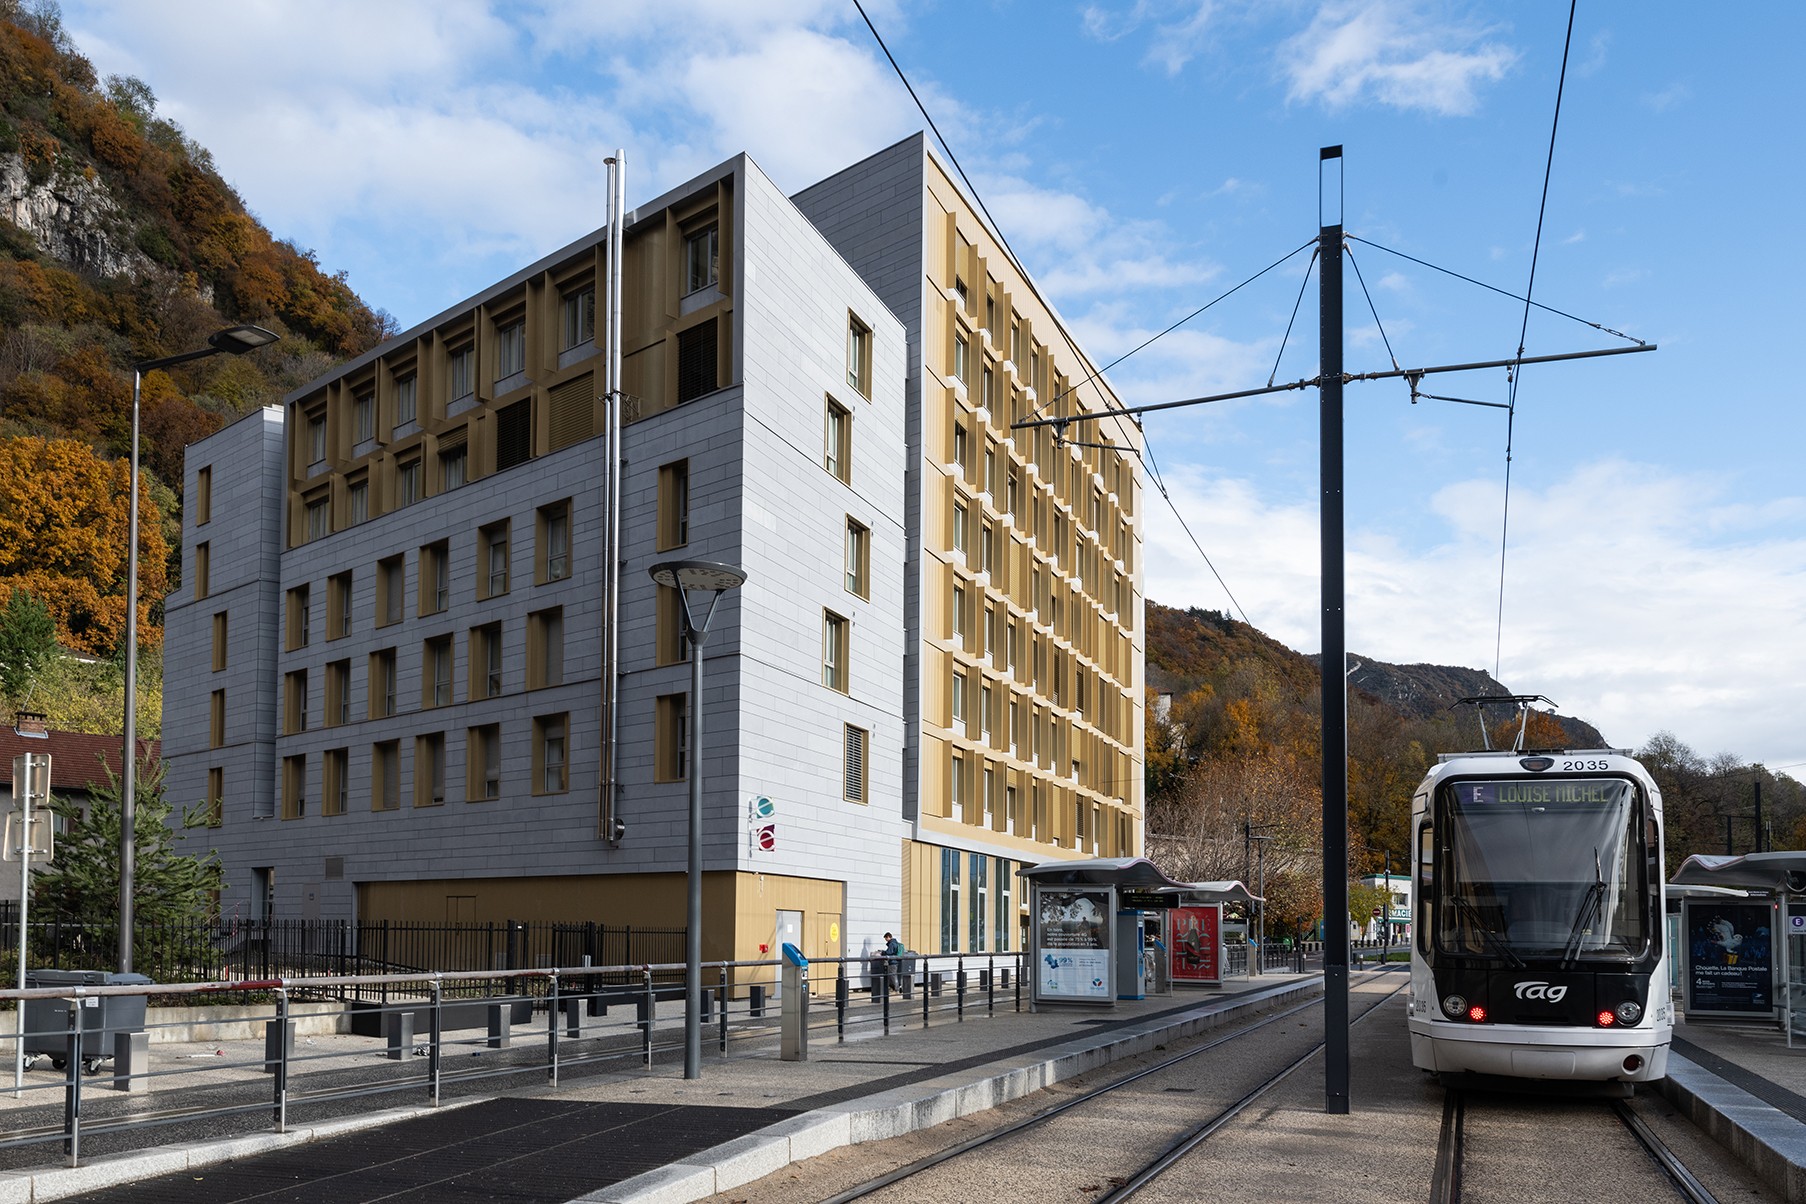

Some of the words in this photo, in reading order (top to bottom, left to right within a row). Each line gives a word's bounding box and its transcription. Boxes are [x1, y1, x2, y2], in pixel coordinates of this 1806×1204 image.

[1563, 760, 1609, 771] 2035
[1473, 786, 1484, 803] E
[1499, 785, 1550, 803] LOUISE
[1555, 785, 1608, 803] MICHEL
[1795, 918, 1801, 926] E
